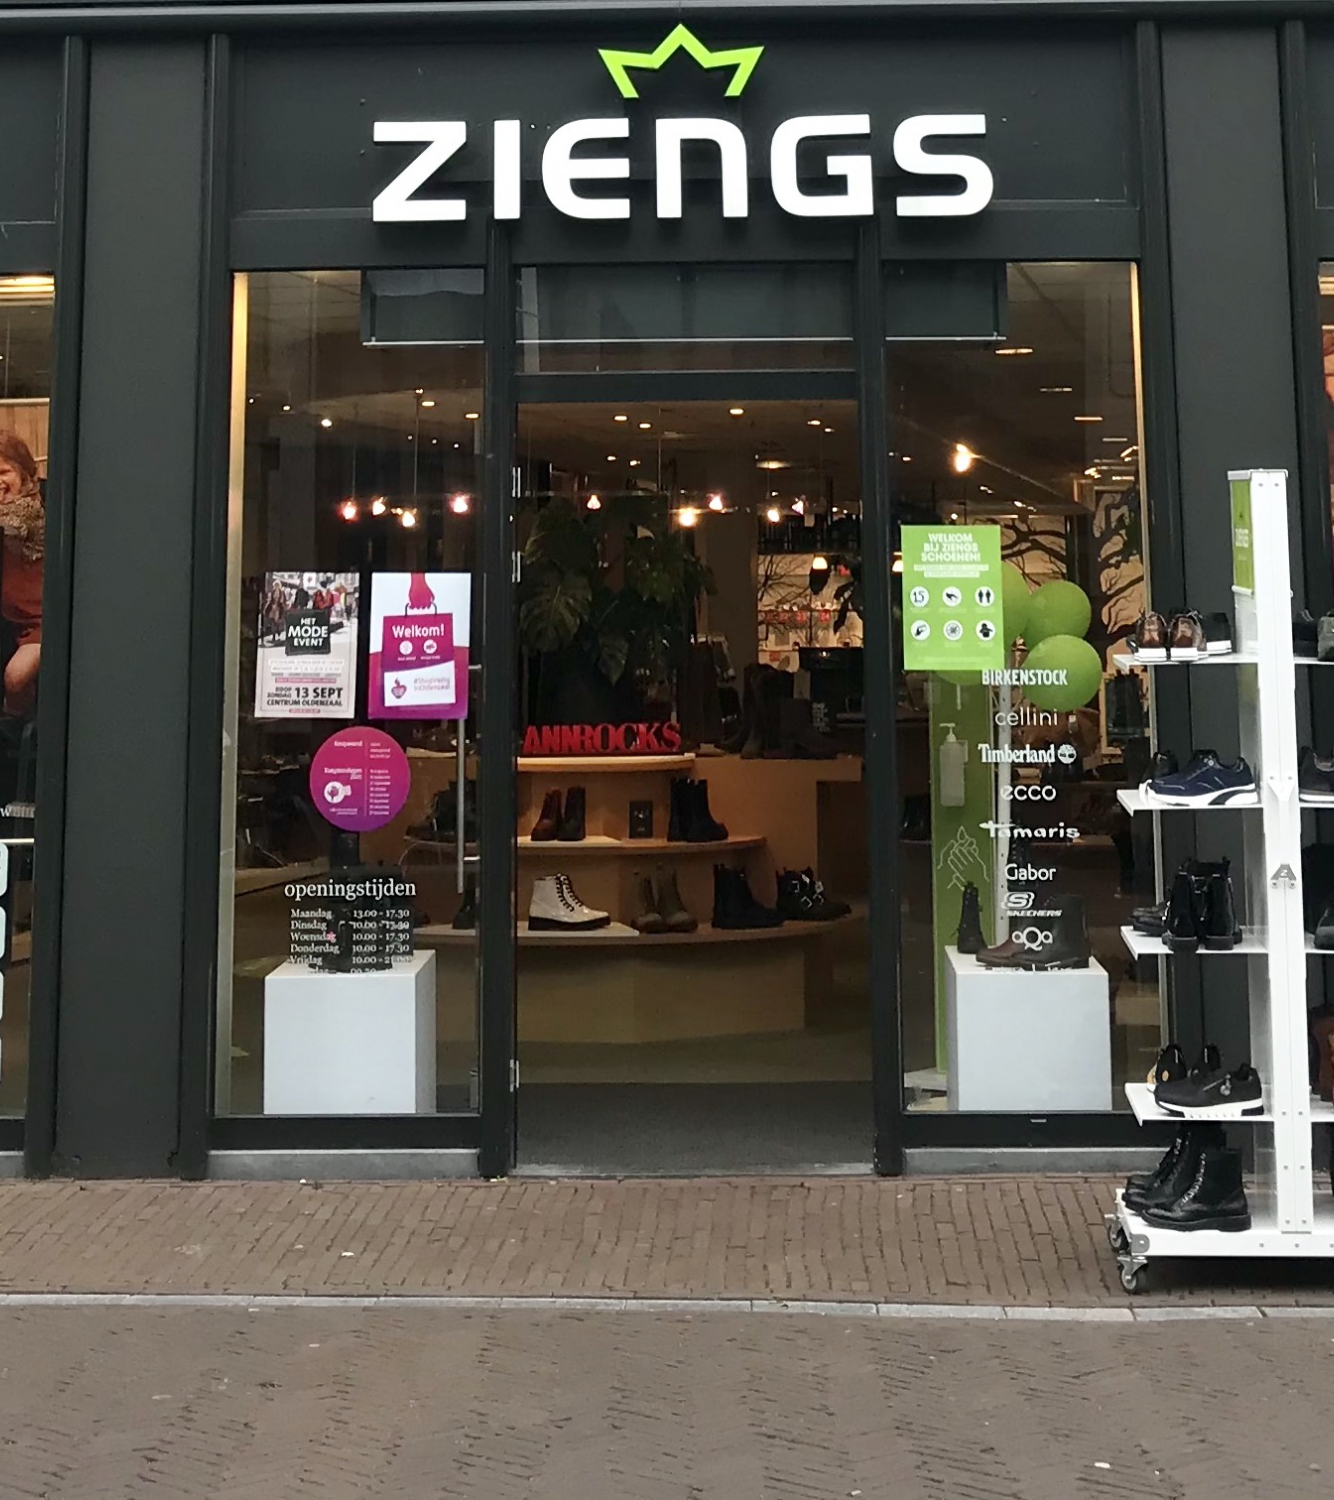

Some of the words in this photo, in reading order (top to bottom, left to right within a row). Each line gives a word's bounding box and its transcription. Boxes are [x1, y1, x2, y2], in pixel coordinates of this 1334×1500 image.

[372, 114, 994, 222] ZIENGS
[928, 533, 973, 543] WELKOM
[923, 543, 939, 552] BIJ
[921, 552, 981, 562] SCHOENEN!
[300, 617, 317, 626] HET
[288, 626, 329, 638] MODE
[392, 624, 445, 639] Welkom!
[293, 637, 324, 647] EVENT
[982, 669, 1068, 686] BIRKENSTOCK
[295, 686, 309, 699] 13
[313, 686, 344, 699] SEPT
[994, 706, 1058, 726] cellini
[977, 743, 1056, 763] Timberland
[1000, 785, 1057, 801] ecco
[1005, 863, 1057, 881] Gabor
[284, 878, 416, 901] openingstijden
[290, 908, 332, 920] Maandag
[352, 909, 377, 918] 13.00
[385, 909, 410, 918] 17.30
[290, 920, 327, 931] Dinsdag
[290, 932, 337, 943] Woensdag
[290, 943, 340, 955] Donderdag
[289, 955, 323, 965] Vrijdag
